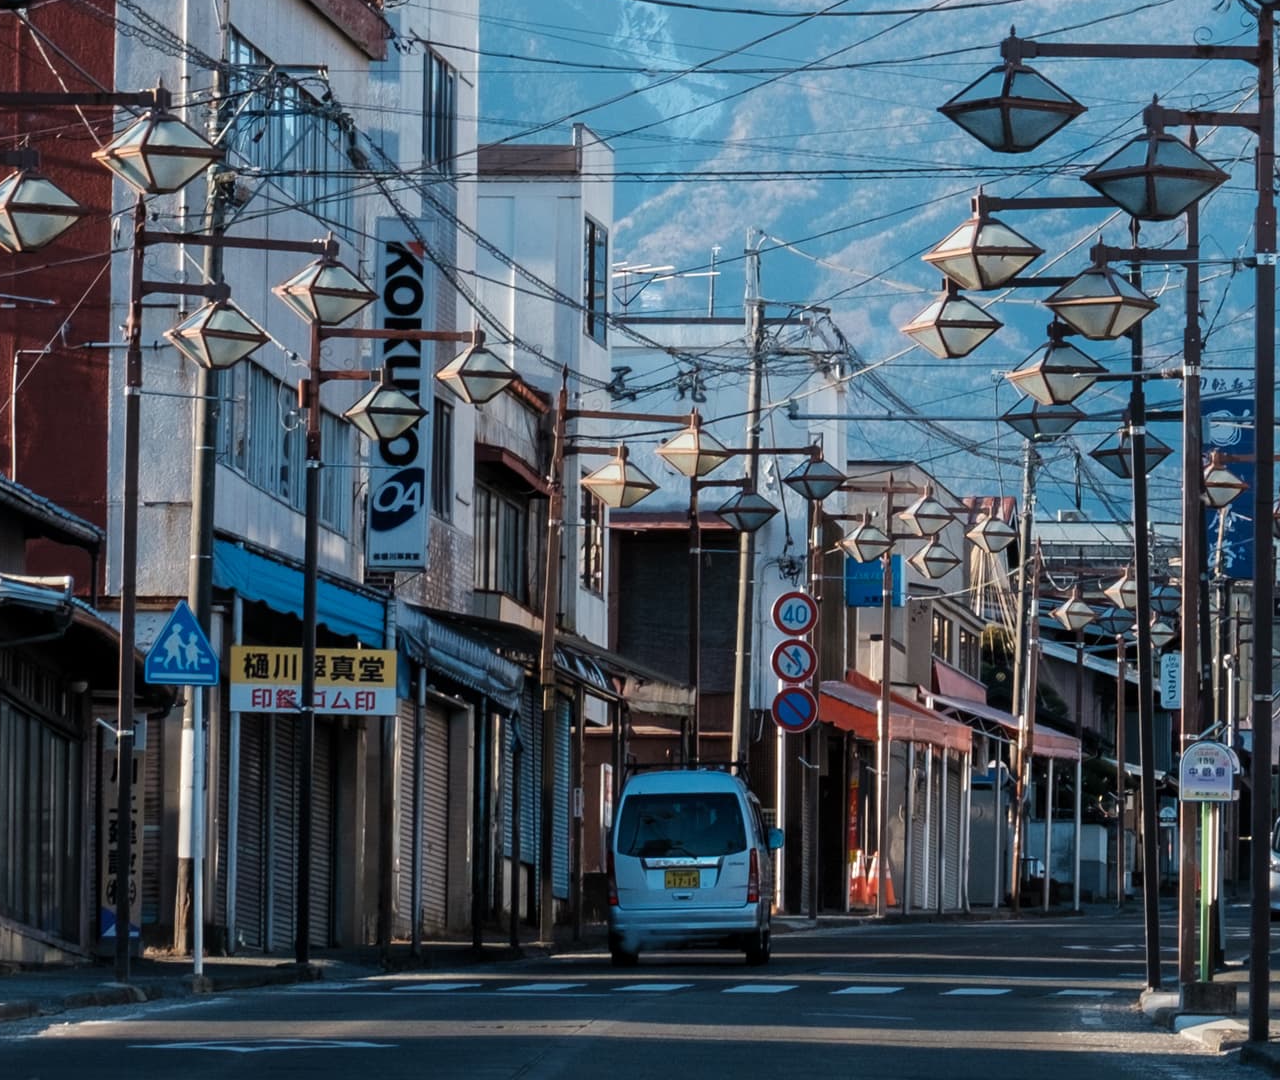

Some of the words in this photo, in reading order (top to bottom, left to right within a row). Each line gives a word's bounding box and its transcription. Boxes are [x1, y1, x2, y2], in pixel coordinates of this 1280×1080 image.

[379, 241, 424, 466] KOKUO
[373, 480, 421, 512] OA
[783, 605, 808, 624] 40
